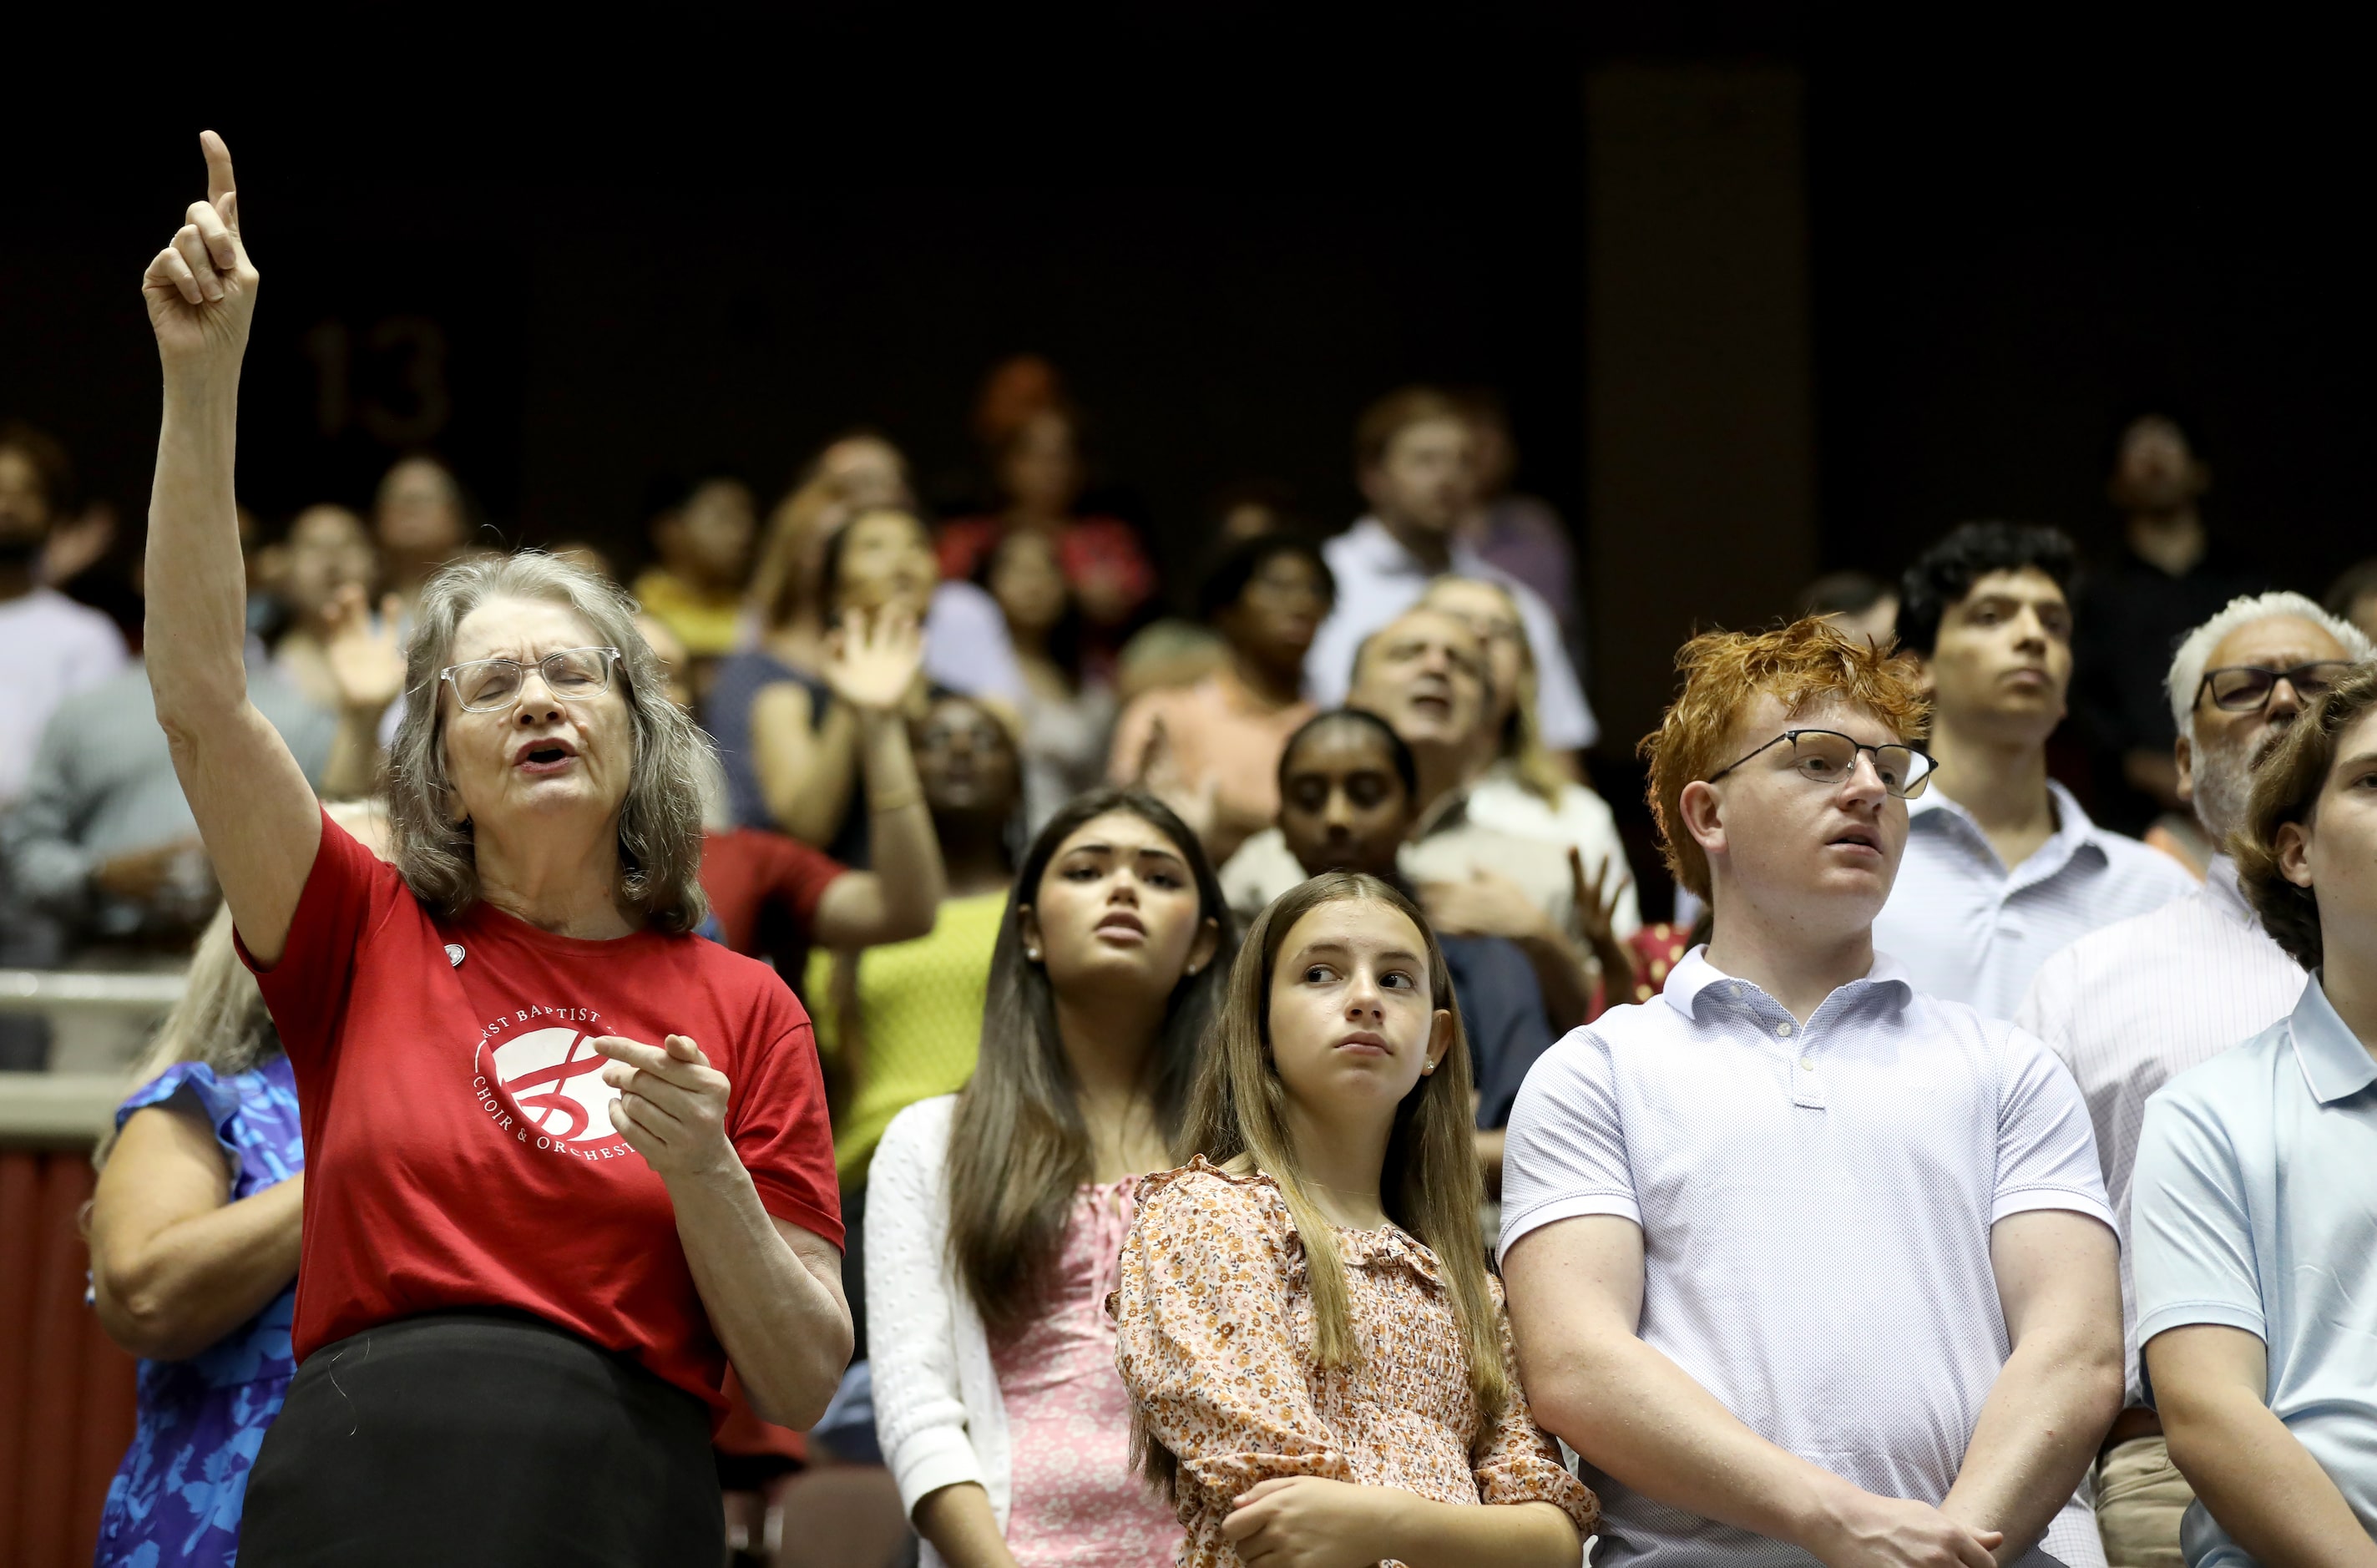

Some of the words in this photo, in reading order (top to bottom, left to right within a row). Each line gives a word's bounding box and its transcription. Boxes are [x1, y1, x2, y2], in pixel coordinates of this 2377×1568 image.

[302, 317, 452, 443] 13
[515, 1004, 600, 1023] BAPTIST
[473, 1075, 513, 1131] CHOIR
[517, 1127, 528, 1143] &
